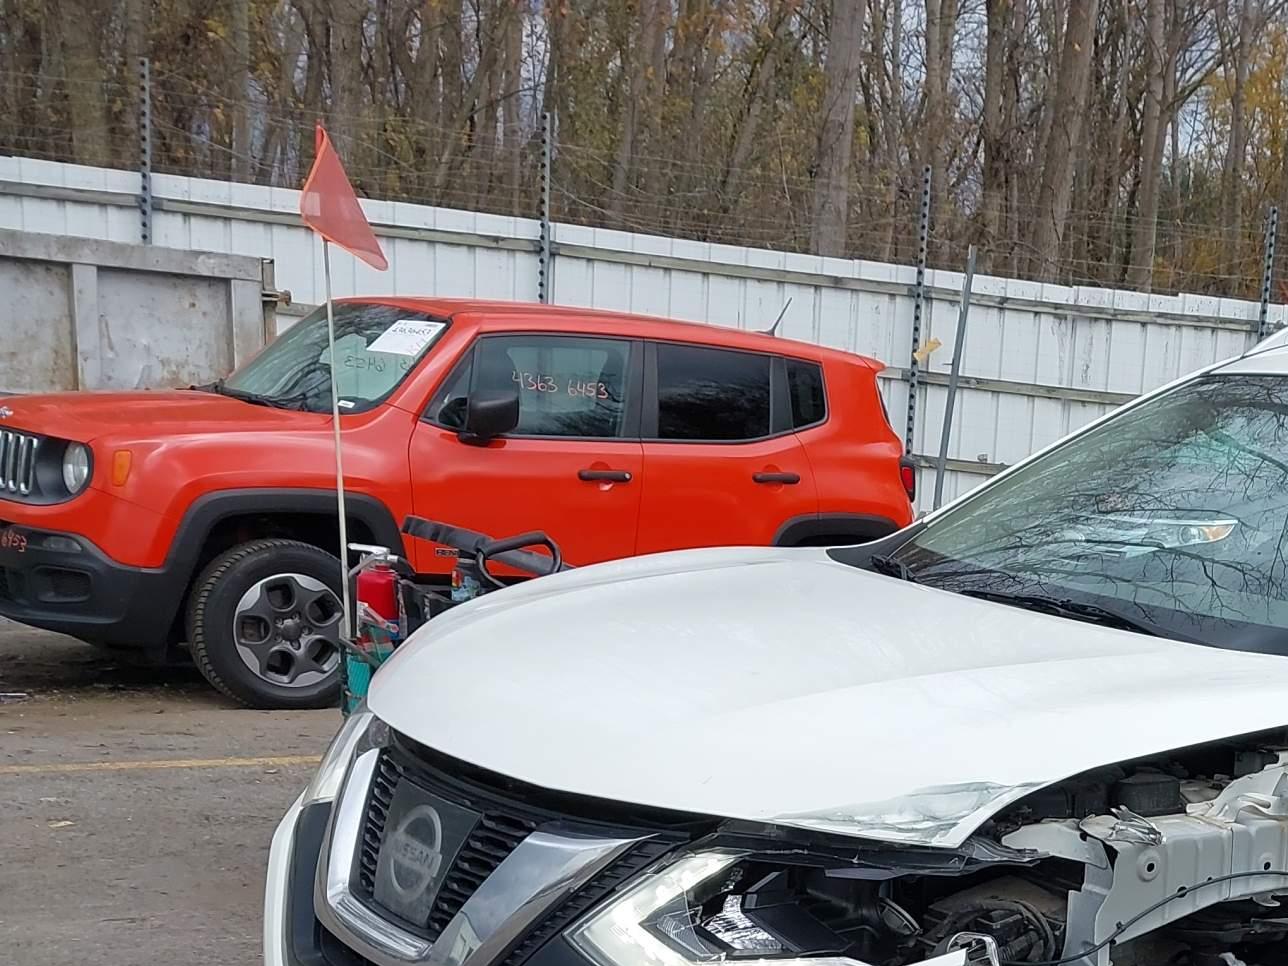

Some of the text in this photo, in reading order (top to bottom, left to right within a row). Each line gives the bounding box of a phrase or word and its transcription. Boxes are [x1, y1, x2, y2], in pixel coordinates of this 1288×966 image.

[511, 371, 609, 399] 4363 6453
[391, 835, 437, 870] NISSAN
